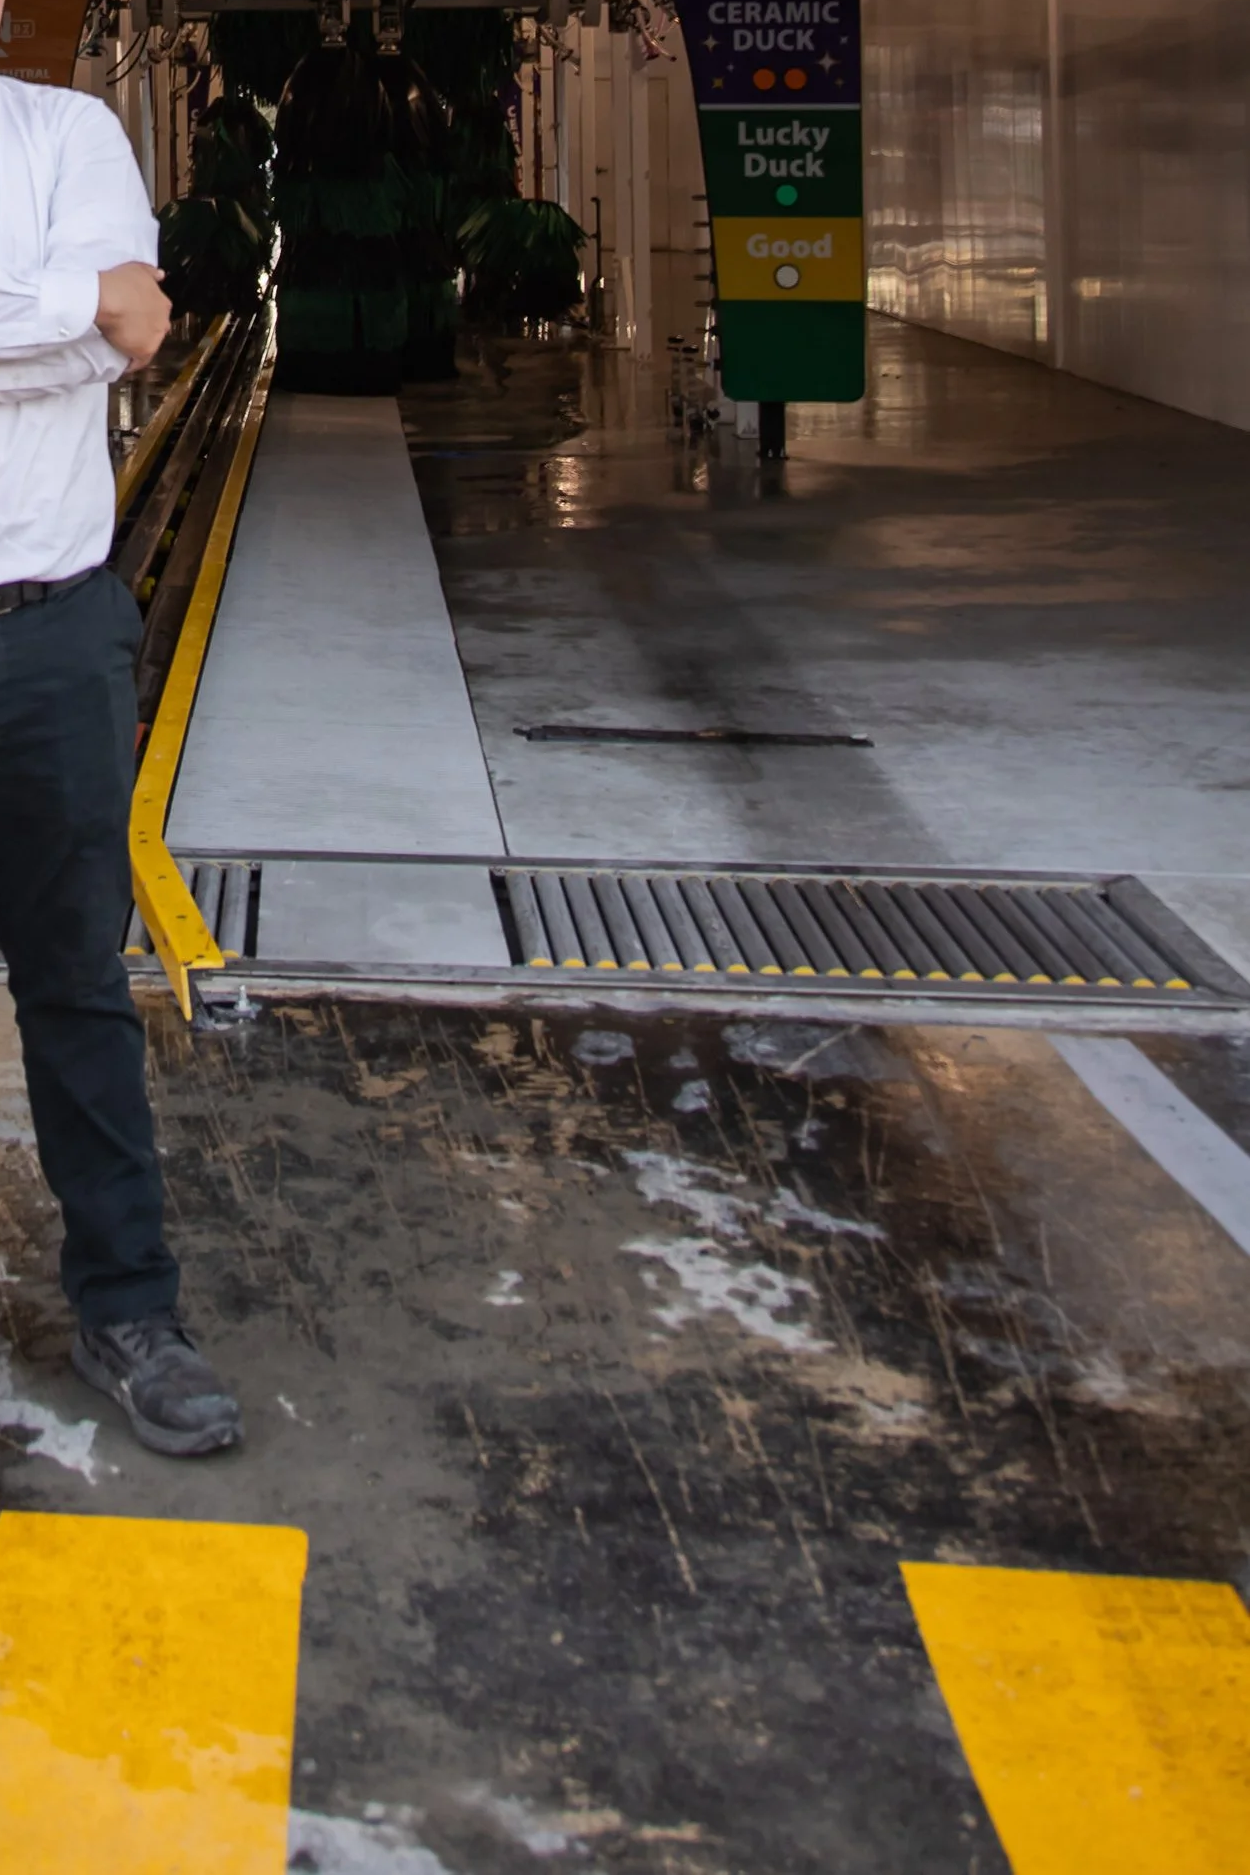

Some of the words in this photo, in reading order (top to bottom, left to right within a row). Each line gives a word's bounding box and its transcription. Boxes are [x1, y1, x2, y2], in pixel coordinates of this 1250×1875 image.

[707, 0, 841, 25] CERAMIC
[732, 28, 816, 52] DUCK
[737, 120, 831, 152] Lucky
[743, 151, 825, 178] Duck
[746, 232, 833, 259] Good
